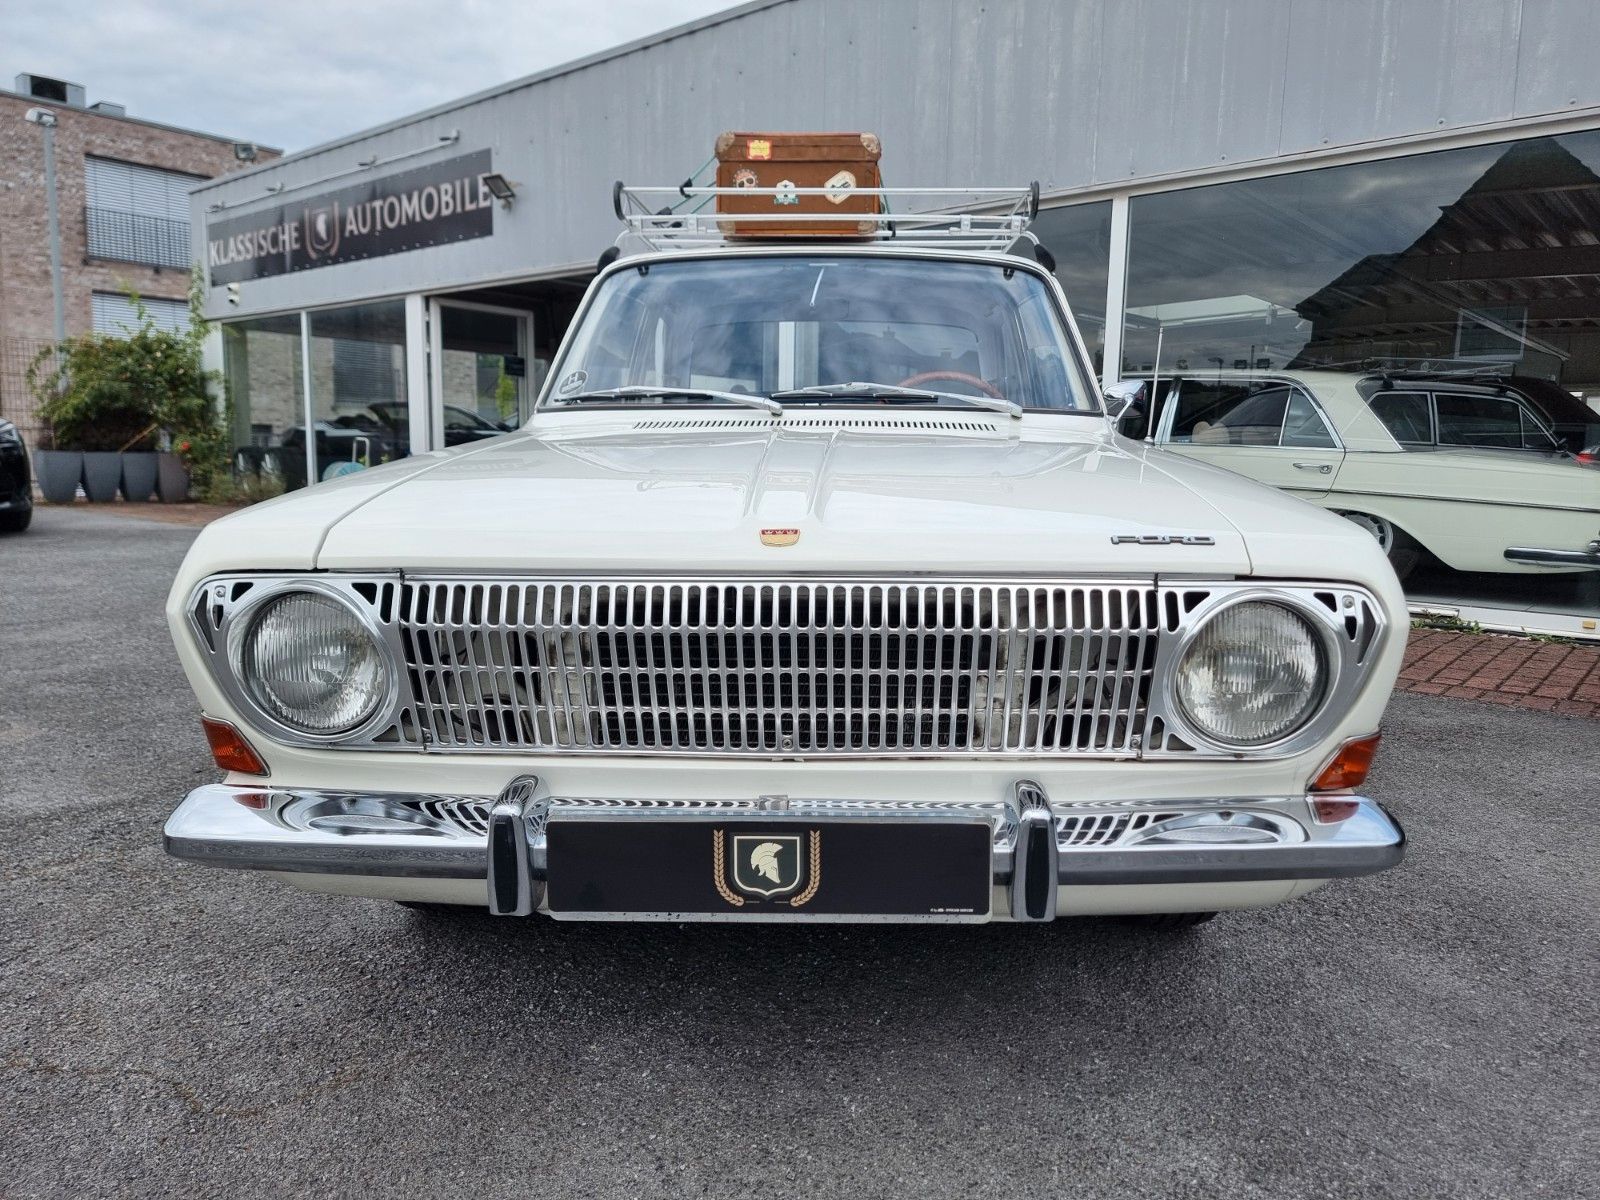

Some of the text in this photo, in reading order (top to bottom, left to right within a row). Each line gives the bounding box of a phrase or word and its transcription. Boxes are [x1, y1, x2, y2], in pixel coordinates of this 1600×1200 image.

[208, 172, 492, 267] KLASSISCHE AUTOMOBILE
[1110, 535, 1216, 546] FORD
